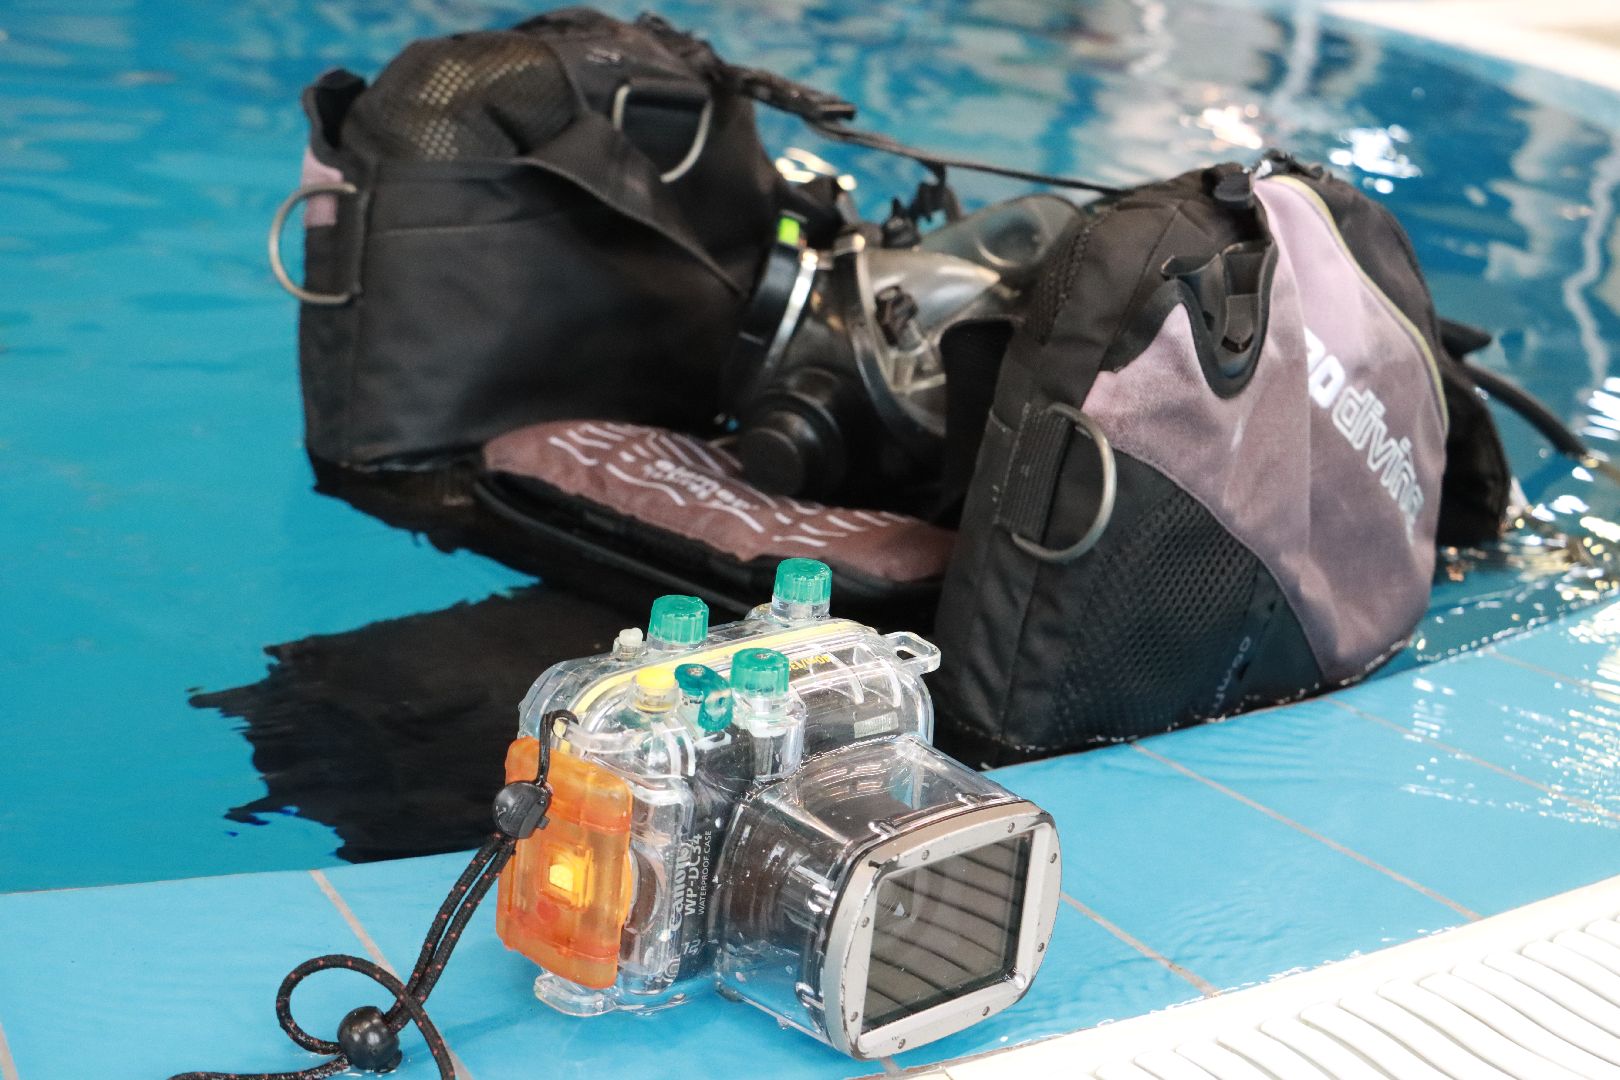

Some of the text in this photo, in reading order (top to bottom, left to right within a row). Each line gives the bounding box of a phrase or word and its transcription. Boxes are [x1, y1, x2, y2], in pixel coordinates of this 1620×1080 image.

[684, 833, 702, 916] WP-DC34
[698, 830, 712, 915] WATERPROOF CASE
